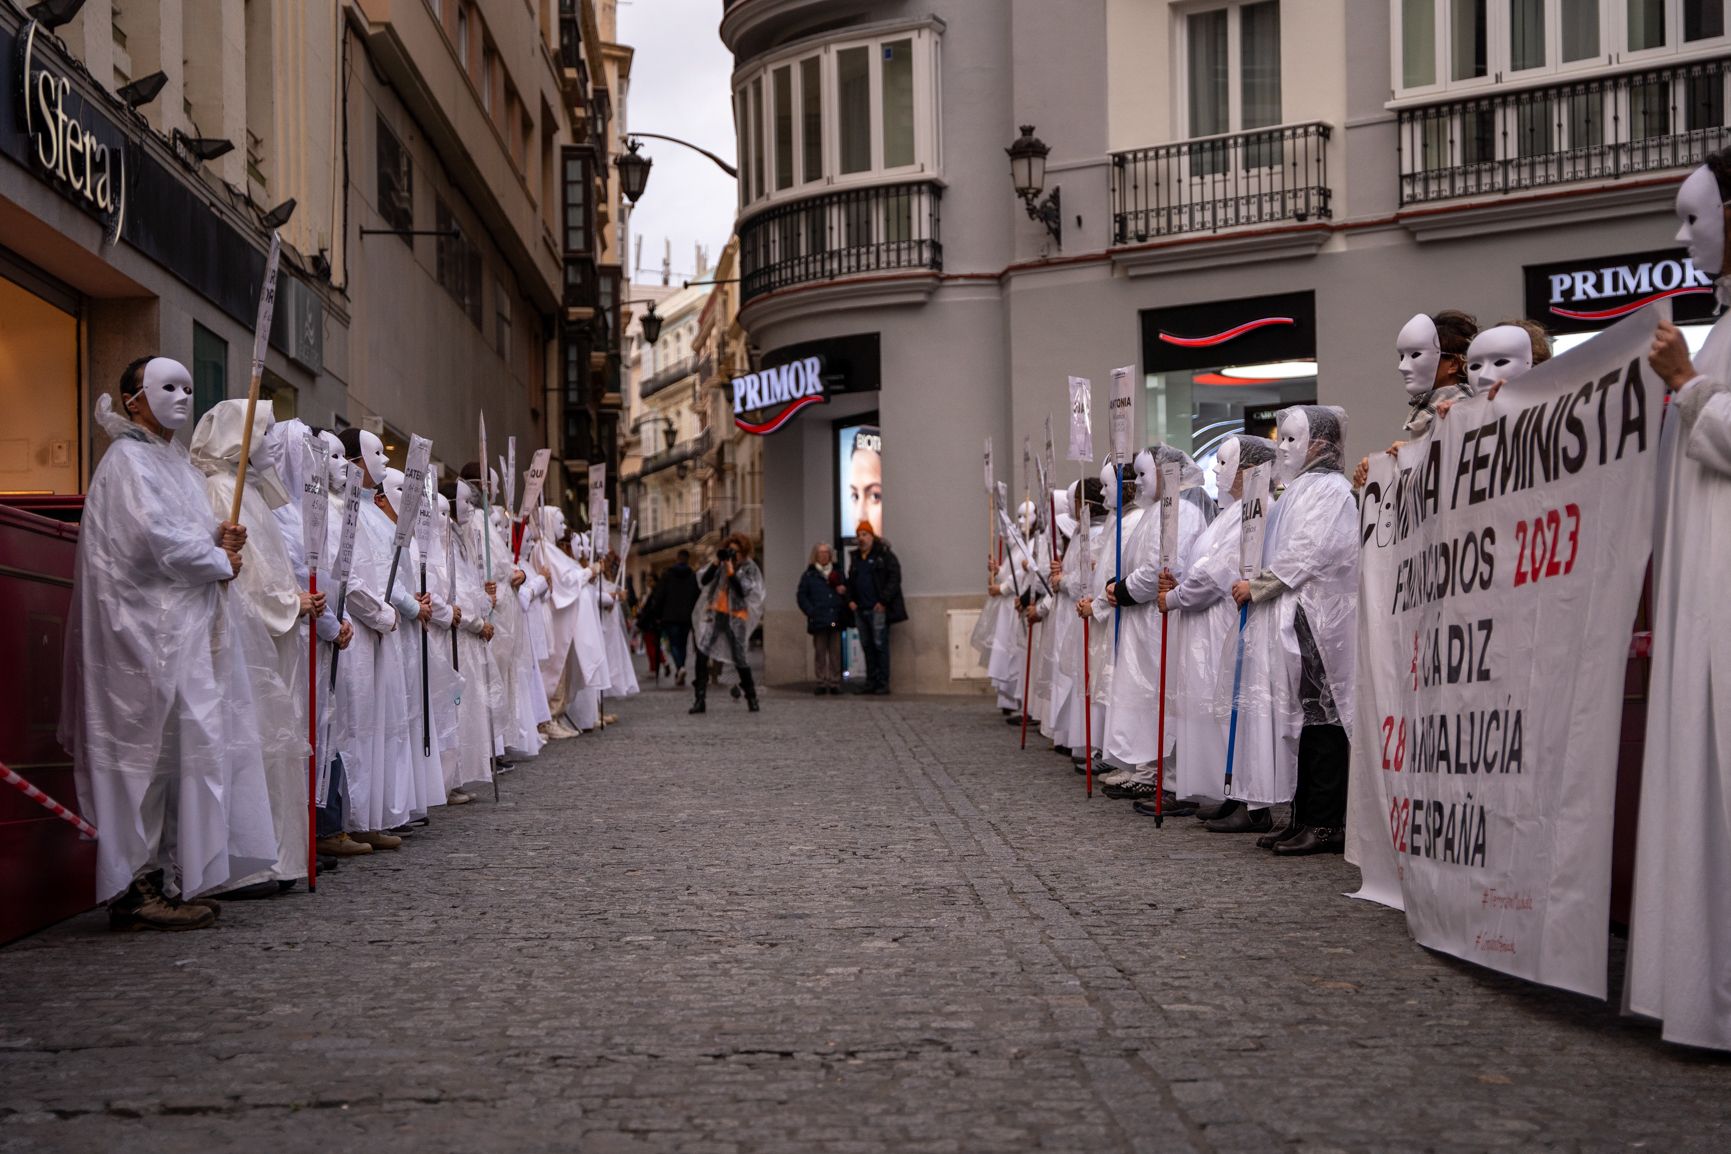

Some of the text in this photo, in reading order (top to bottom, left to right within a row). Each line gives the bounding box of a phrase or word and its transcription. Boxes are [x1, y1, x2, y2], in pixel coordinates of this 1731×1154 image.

[731, 355, 824, 415] PRIMOR
[1450, 357, 1648, 510] FEMINISTA
[1513, 502, 1583, 588] 2023
[1422, 611, 1494, 688] CÁDIZ
[1382, 693, 1523, 775] 28 ANDALUCÍA
[1410, 791, 1487, 868] ESPAÑA
